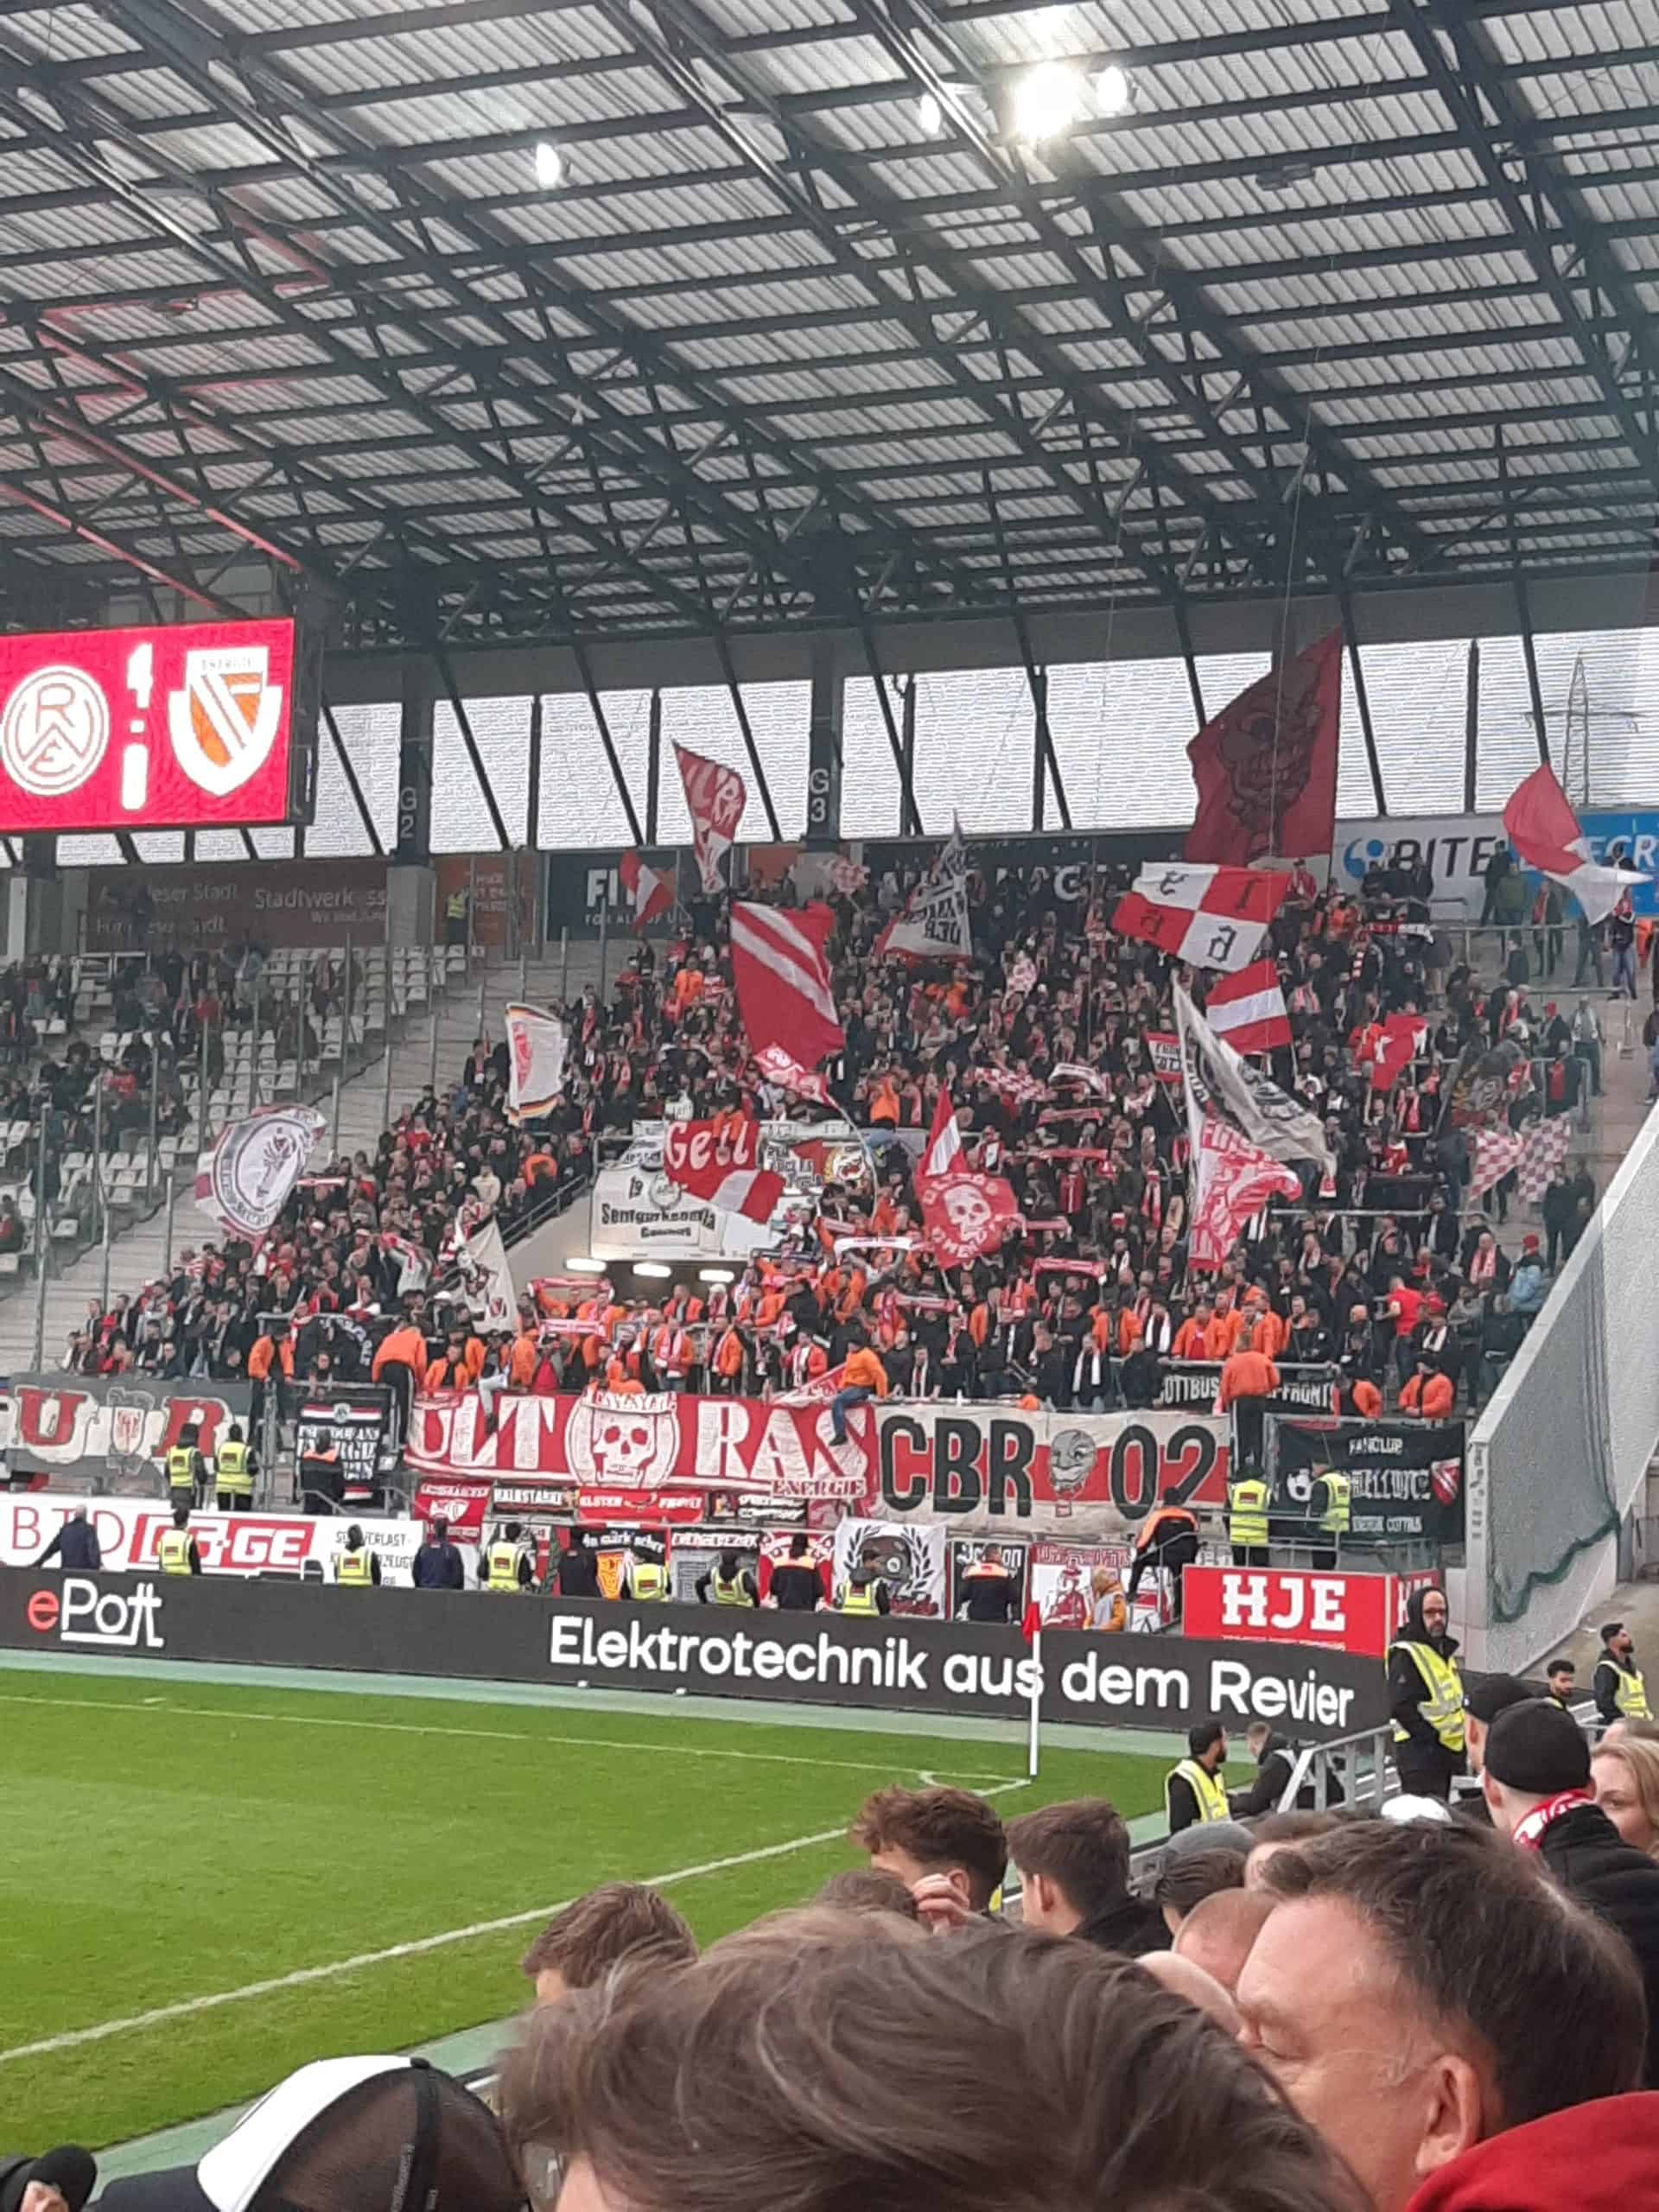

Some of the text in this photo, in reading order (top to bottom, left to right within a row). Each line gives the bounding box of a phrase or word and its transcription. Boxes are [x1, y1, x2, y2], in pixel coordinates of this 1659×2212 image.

[664, 1121, 749, 1169] Geil
[880, 1414, 1217, 1521] CBR 02
[1222, 1574, 1345, 1631] HJE
[550, 1615, 1355, 1727] Elektrotechnik aus dem Revier
